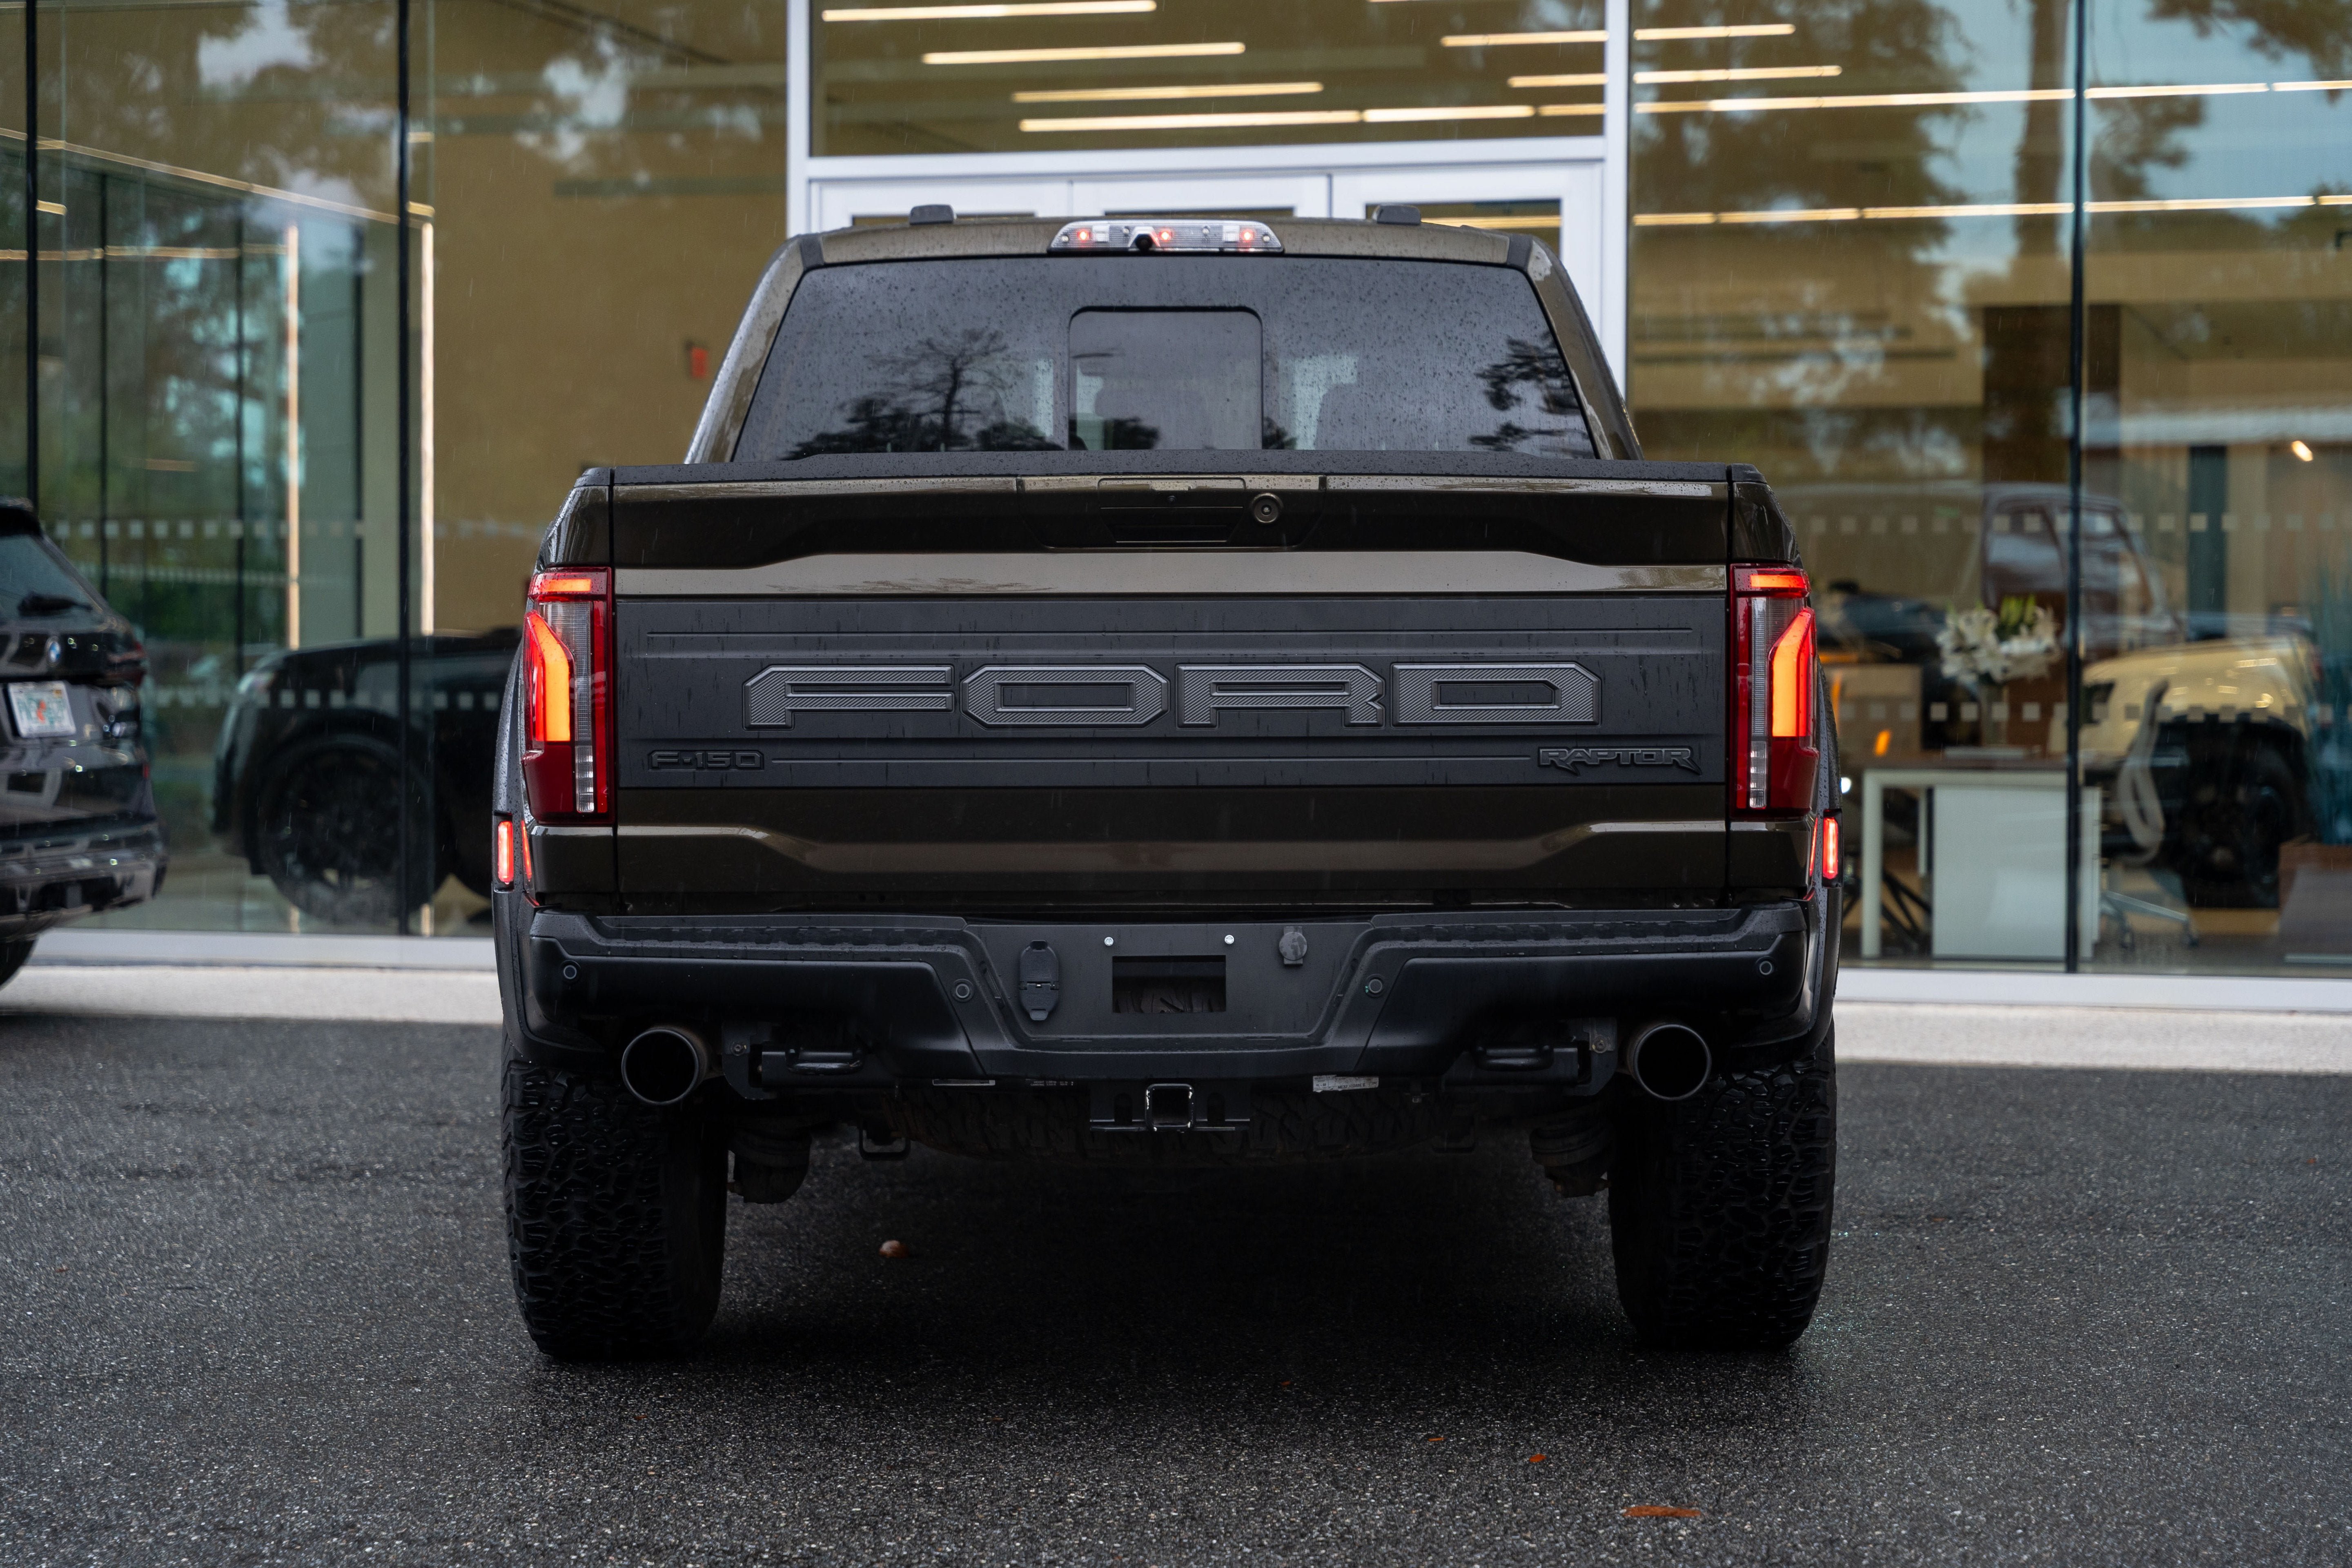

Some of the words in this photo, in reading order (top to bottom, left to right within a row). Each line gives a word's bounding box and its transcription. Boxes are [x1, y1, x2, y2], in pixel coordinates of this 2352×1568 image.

[744, 663, 1600, 729] FORD
[650, 751, 762, 769] F-150
[1539, 748, 1702, 775] RAPTOR
